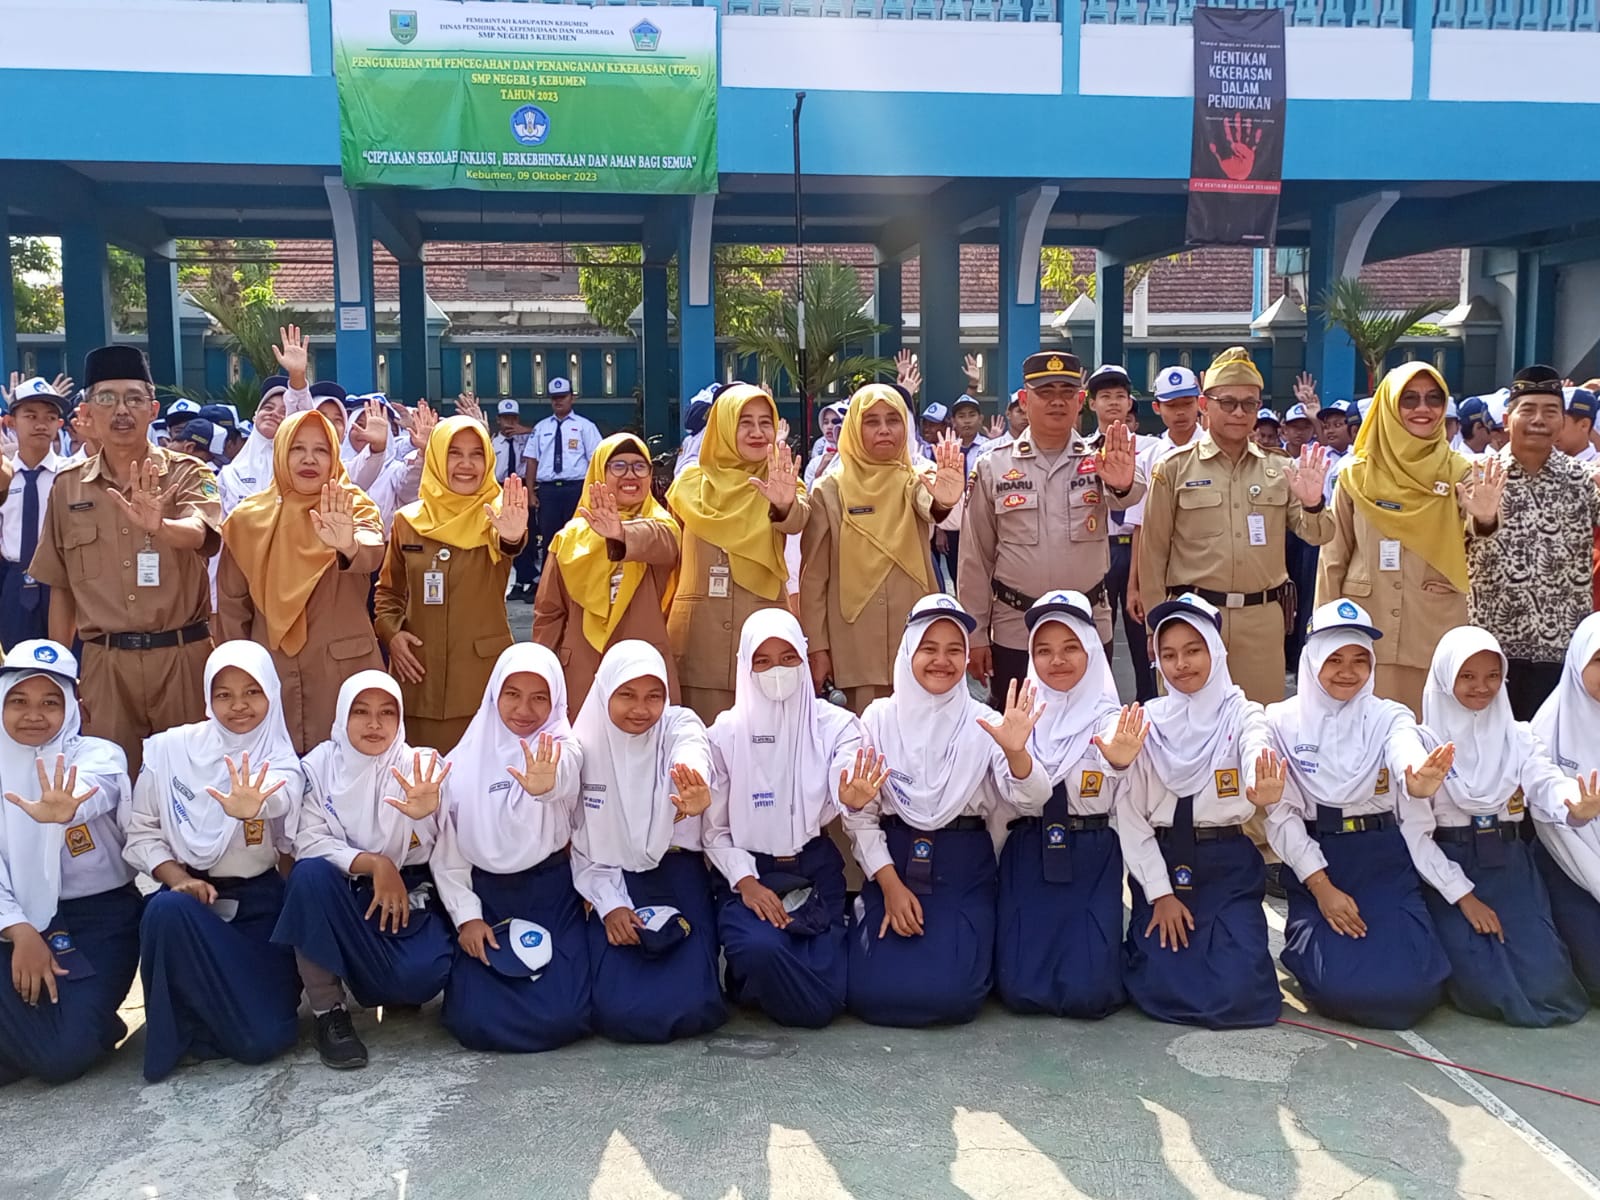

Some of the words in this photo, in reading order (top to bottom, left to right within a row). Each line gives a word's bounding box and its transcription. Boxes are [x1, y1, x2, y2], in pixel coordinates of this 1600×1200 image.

[466, 17, 511, 25] PEMERINTAH
[510, 26, 558, 34] KEPEMUDAAN
[497, 32, 529, 40] NEGERI
[536, 34, 577, 42] KEBUMEN
[1213, 50, 1267, 66] HENTIKAN
[352, 57, 423, 69] PENGUKUHAN
[424, 58, 442, 69] TIM
[444, 58, 511, 71] PENCEGAHAN
[513, 60, 535, 71] DAN
[536, 61, 605, 74] PENANGANAN
[606, 63, 666, 75] KEKERASAN
[668, 65, 701, 78] (TPPK)
[1208, 64, 1273, 81] KEKERASAN
[471, 74, 491, 84] SMP
[493, 74, 530, 86] NEGERI
[531, 77, 537, 87] 5
[539, 75, 587, 87] KEBUMEN
[1221, 81, 1260, 95] DALAM
[500, 89, 536, 101] TAHUN
[537, 91, 559, 102] 2023
[1207, 94, 1272, 110] PENDIDIKAN
[417, 151, 458, 164] SEKOLAH
[460, 152, 496, 165] INKLUSI
[502, 153, 586, 167] BERKEBHINEKAAN
[588, 154, 608, 167] DAN
[610, 155, 636, 168] AMAN
[638, 155, 661, 168] BAGI
[466, 170, 516, 182] Kebumen,
[517, 171, 529, 180] 09
[532, 171, 572, 181] Oktober
[574, 172, 598, 182] 2023
[996, 481, 1033, 493] NDARU
